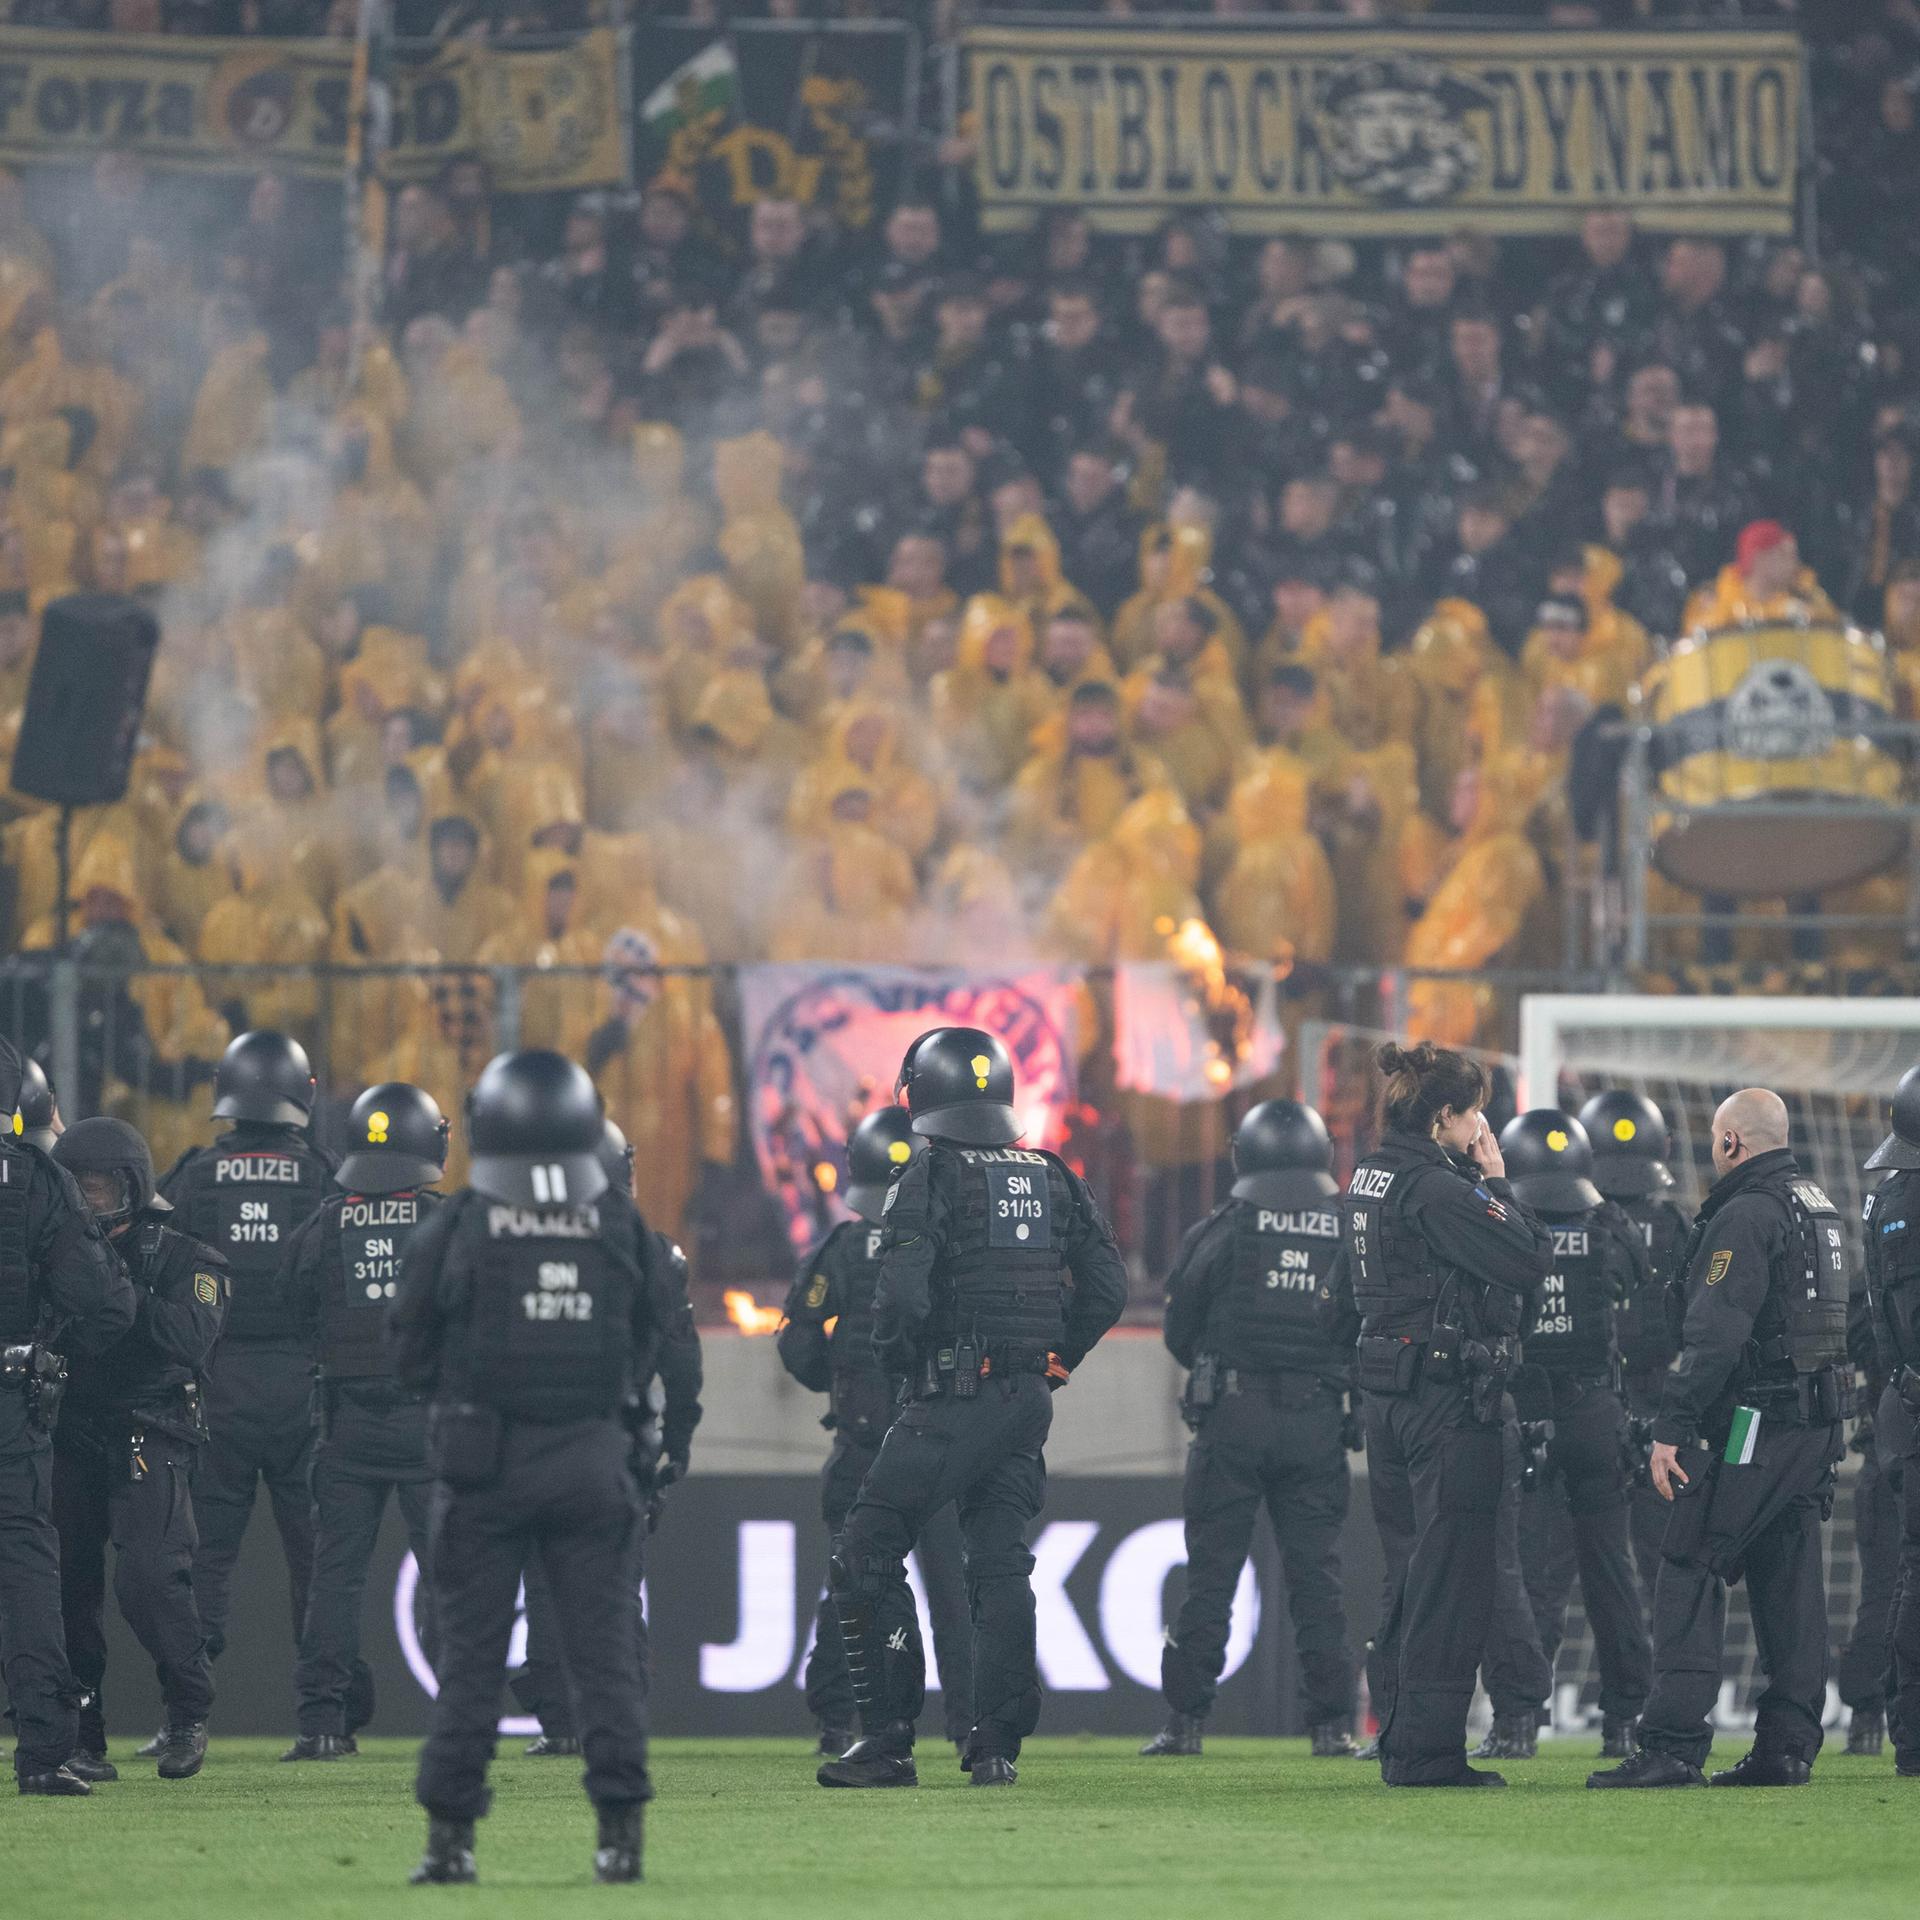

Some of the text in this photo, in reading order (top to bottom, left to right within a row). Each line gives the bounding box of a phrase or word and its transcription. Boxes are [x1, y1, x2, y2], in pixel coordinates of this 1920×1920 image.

[983, 64, 1789, 194] OSTBLOCK DYNAMO
[960, 1149, 1048, 1166] POLIZEI
[216, 1158, 299, 1182] POLIZEI
[1008, 1176, 1032, 1195] SN
[1348, 1167, 1395, 1199] POLIZEI
[240, 1202, 268, 1221] SN
[340, 1200, 417, 1229] POLIZEI
[998, 1199, 1043, 1218] 31/13
[1258, 1210, 1340, 1237] POLIZEI
[1353, 1211, 1368, 1231] SN
[230, 1223, 279, 1242] 31/13
[1827, 1228, 1841, 1247] SN
[365, 1238, 393, 1257] SN
[1354, 1236, 1367, 1255] 13
[1280, 1249, 1309, 1269] SN
[1831, 1252, 1842, 1270] 13
[1267, 1270, 1317, 1291] 31/11
